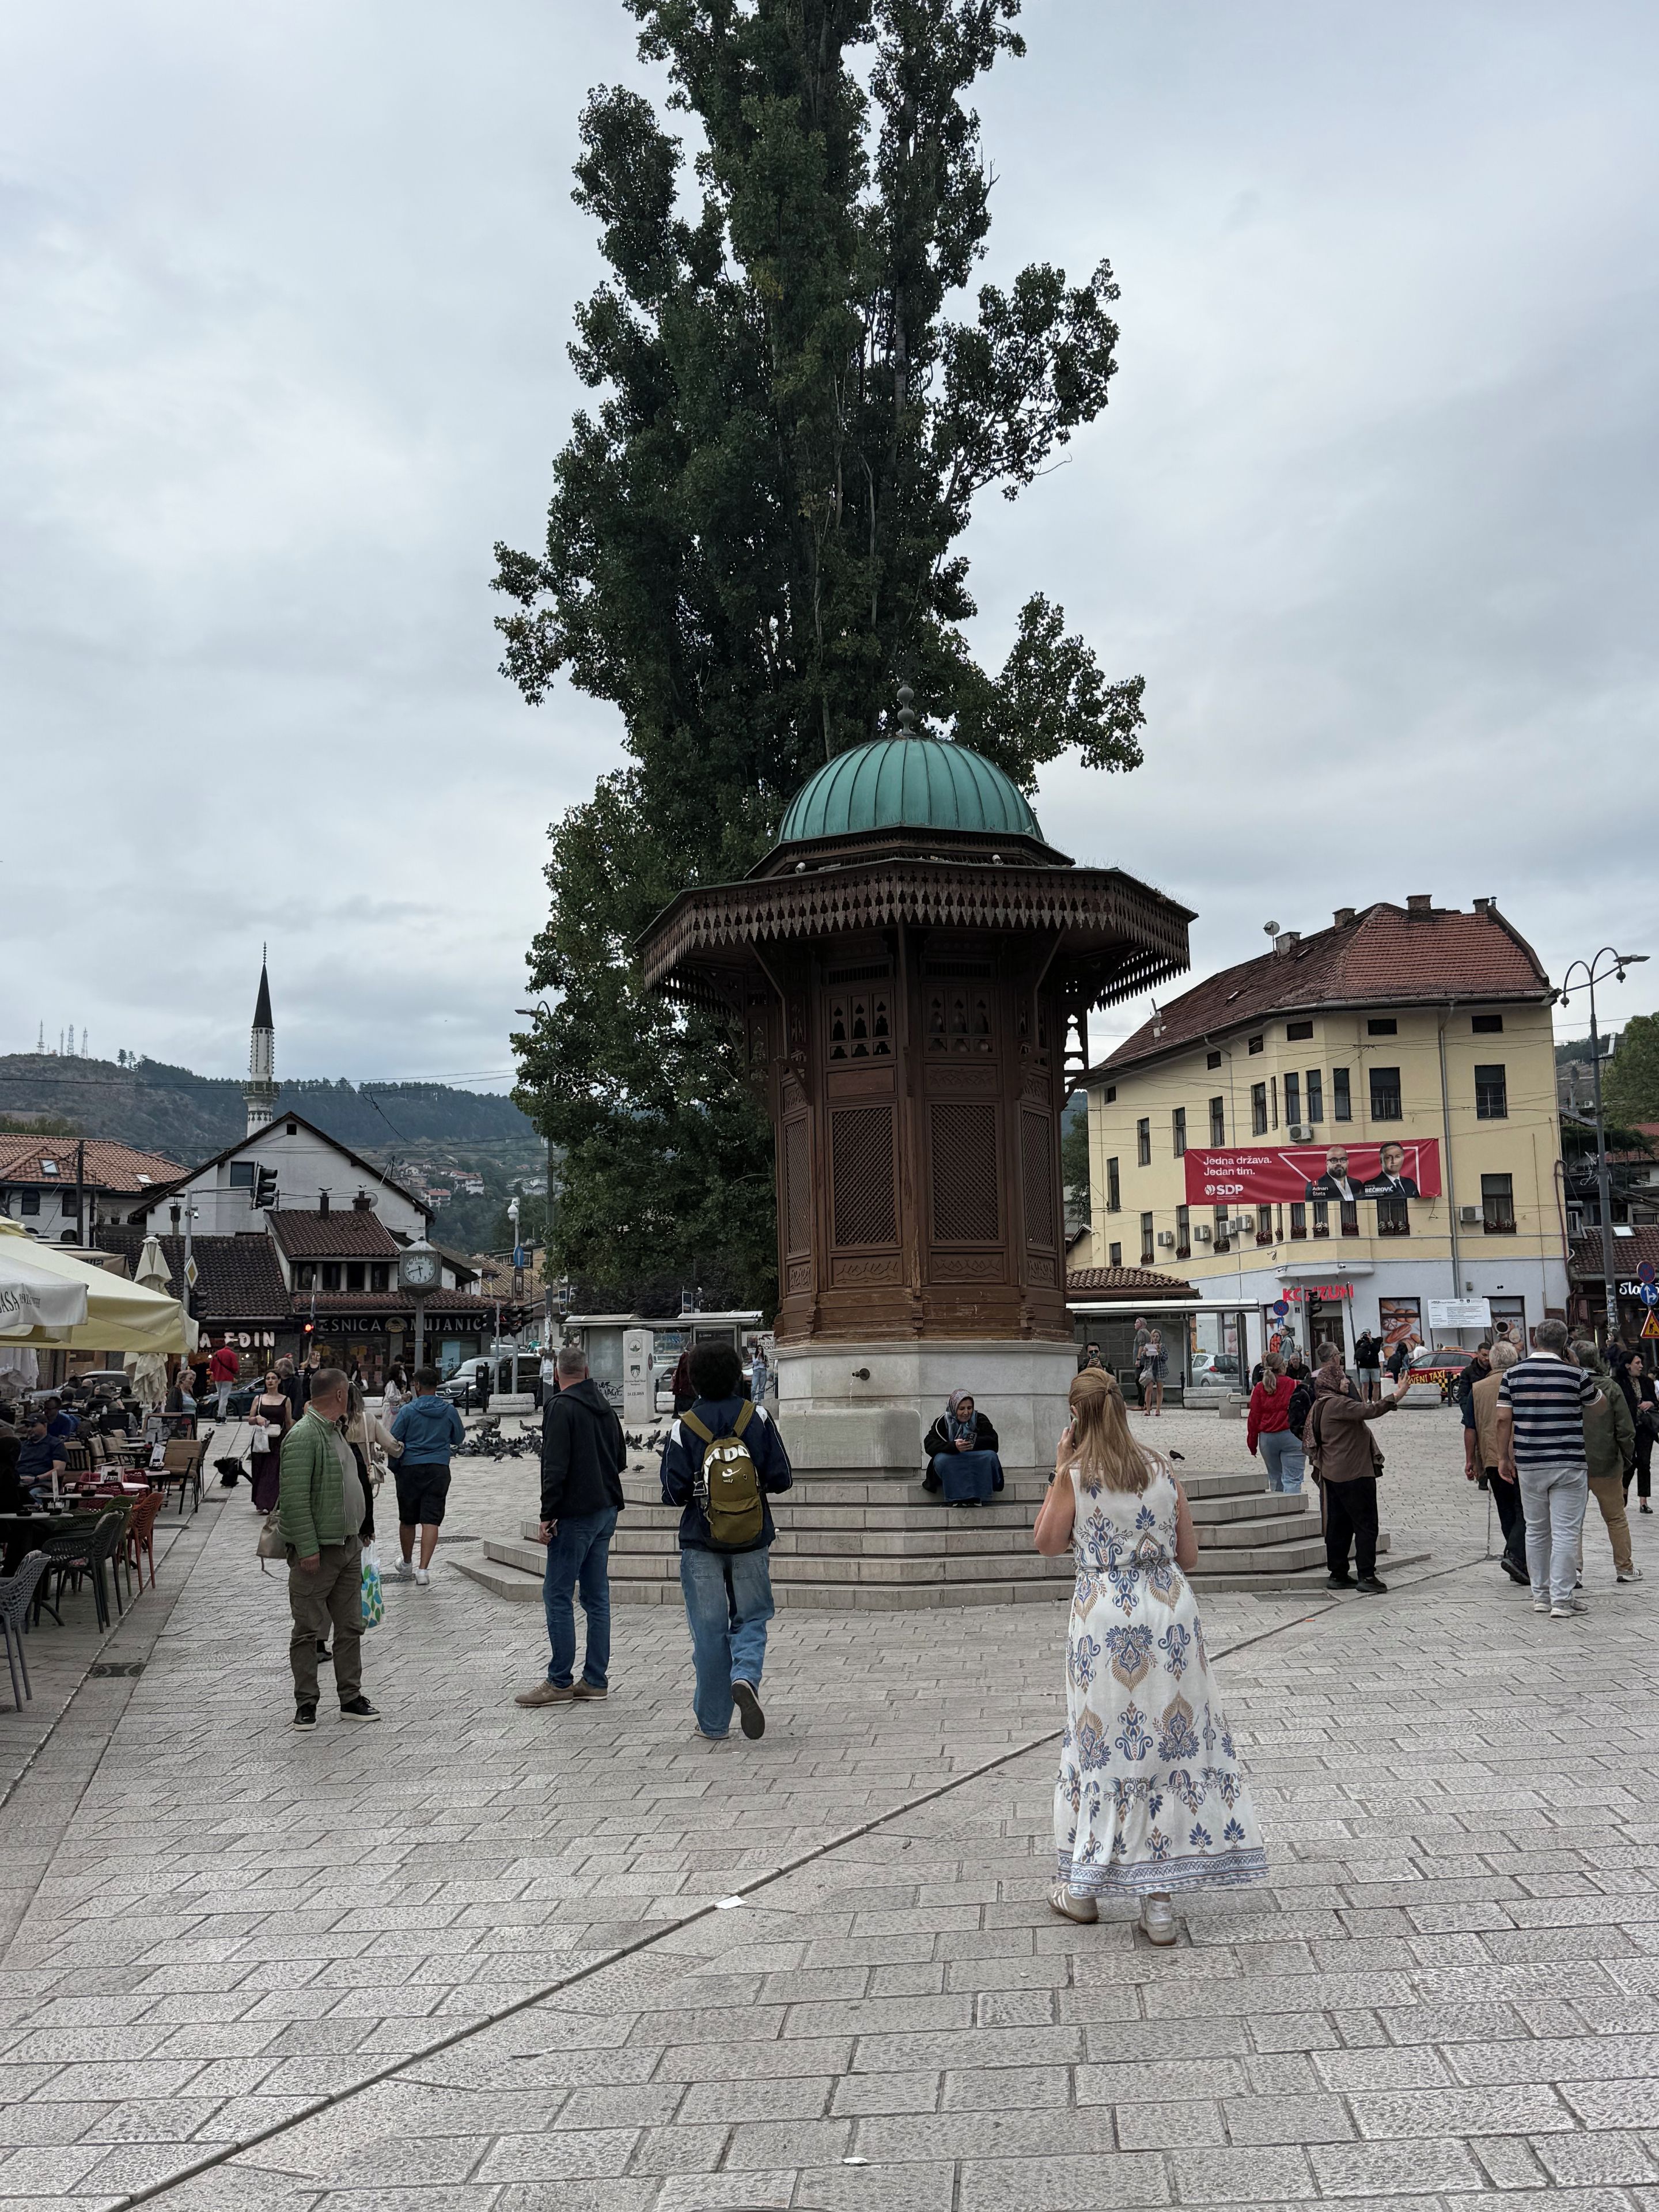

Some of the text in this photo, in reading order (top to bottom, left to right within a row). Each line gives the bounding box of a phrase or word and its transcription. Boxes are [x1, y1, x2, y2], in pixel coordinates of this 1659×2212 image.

[1203, 1156, 1272, 1165] Jedna država.
[1204, 1167, 1234, 1176] Jedan
[1216, 1184, 1244, 1195] SDP
[0, 1291, 20, 1313] ASA
[1429, 1370, 1445, 1381] TAXI
[724, 1445, 750, 1461] DO
